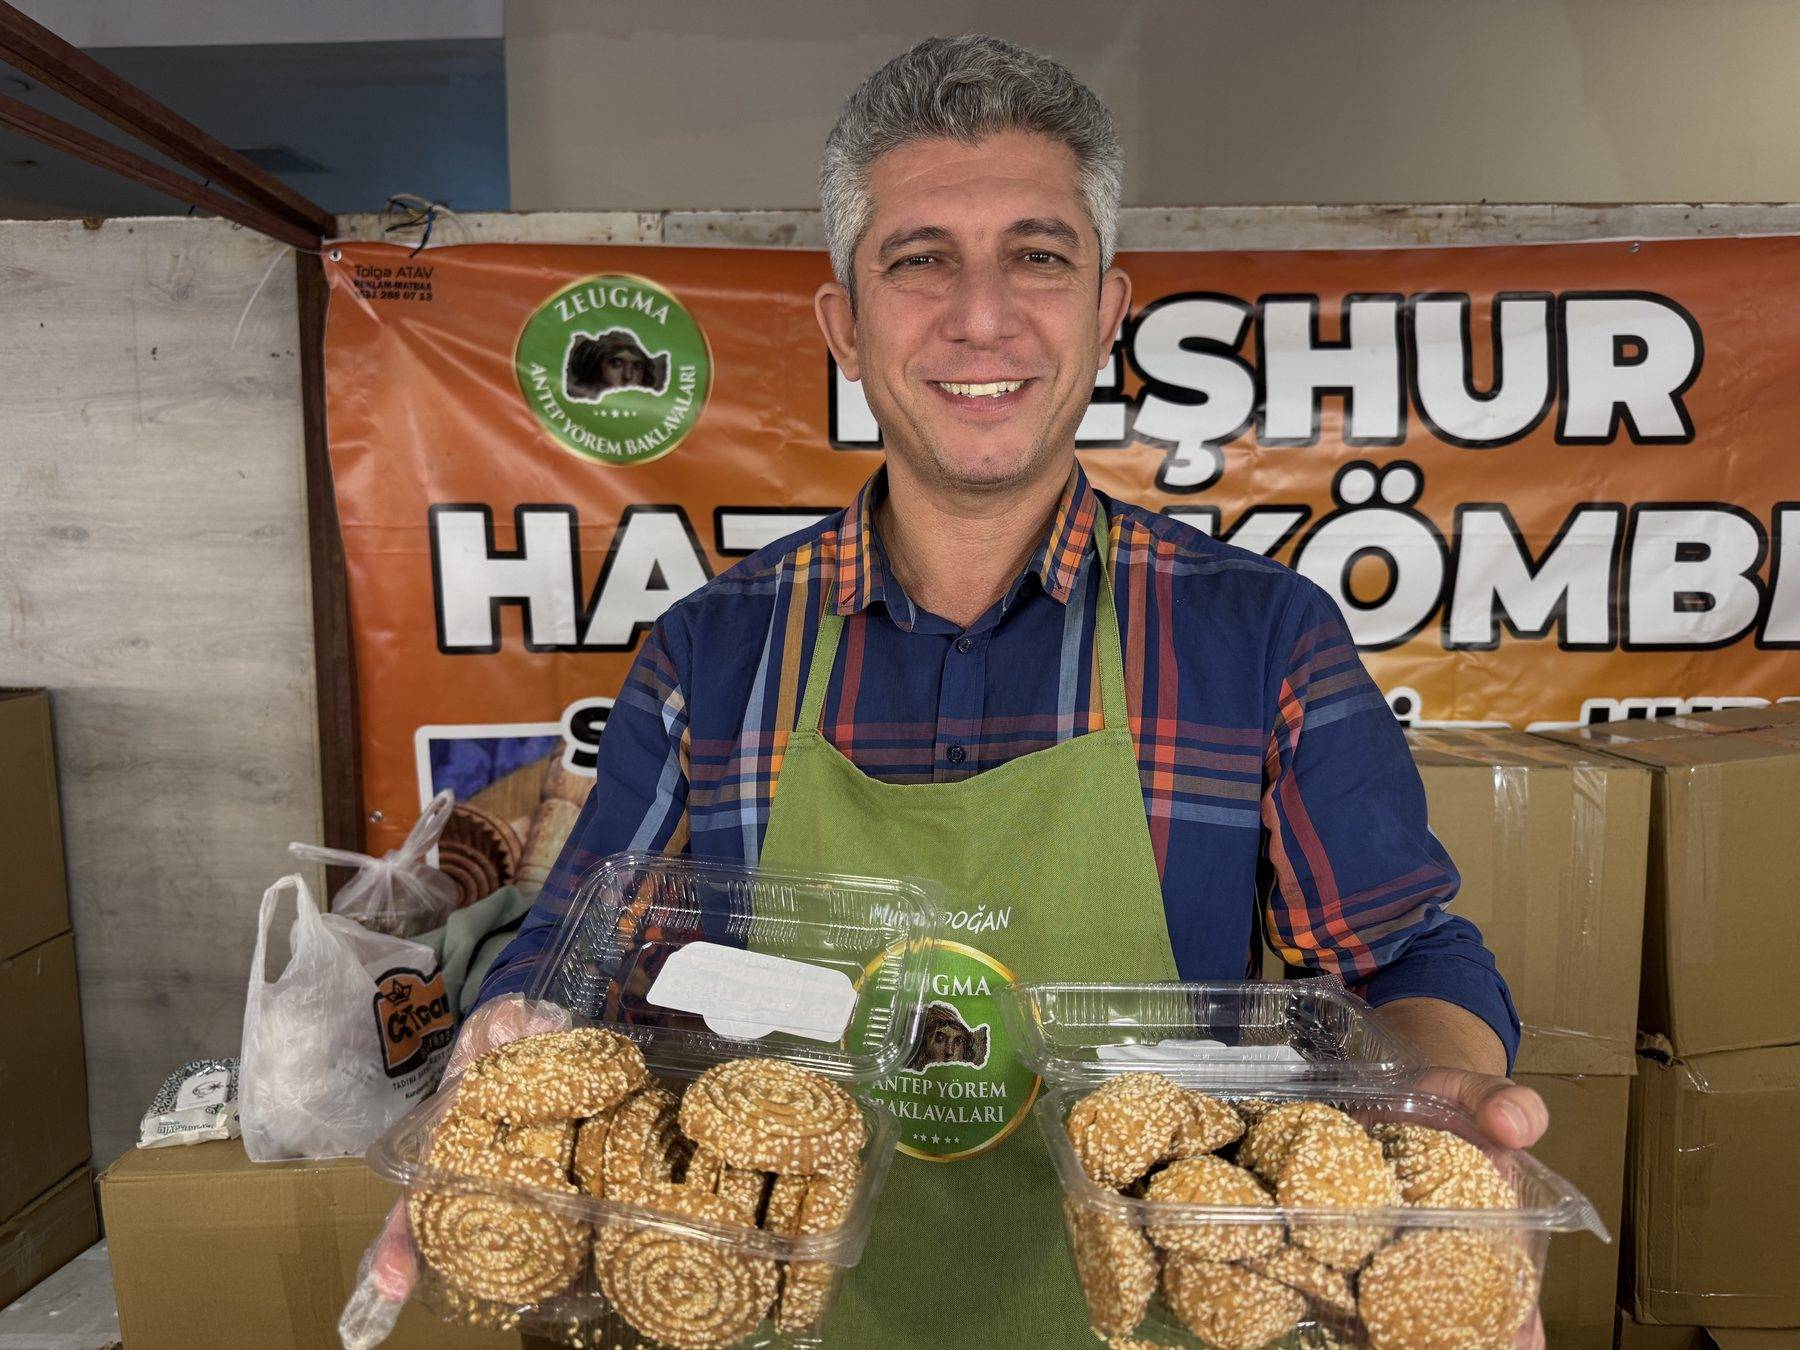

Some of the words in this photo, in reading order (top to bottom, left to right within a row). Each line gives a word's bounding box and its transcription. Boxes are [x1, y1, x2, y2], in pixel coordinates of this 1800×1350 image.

[354, 265, 392, 280] Tolga
[396, 266, 434, 279] ATAV
[554, 287, 670, 327] ZEUGMA
[530, 361, 565, 421] ANTEP
[562, 417, 624, 456] YÖREM
[624, 364, 696, 456] BAKLAVALARI
[1160, 458, 1800, 652] ÖMB
[872, 1076, 932, 1095] ANTEP
[937, 1078, 1007, 1099] YÖREM
